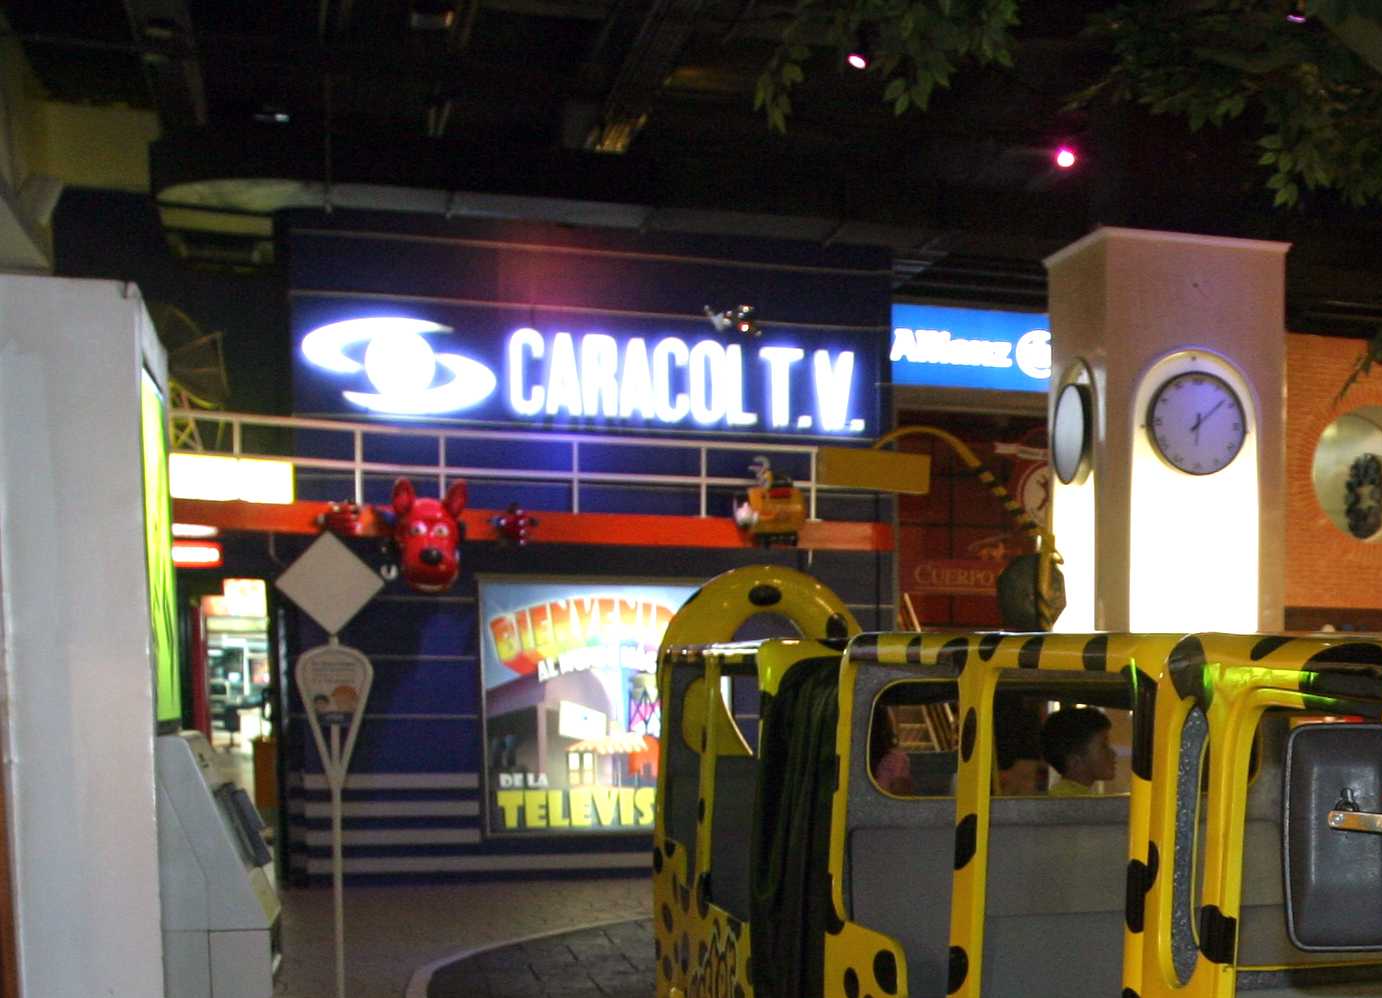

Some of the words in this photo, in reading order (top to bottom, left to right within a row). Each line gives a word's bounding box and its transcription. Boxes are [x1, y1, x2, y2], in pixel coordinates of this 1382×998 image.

[890, 328, 1013, 368] Allianz
[509, 328, 758, 425] CARACOL
[759, 346, 865, 431] T.V.
[538, 657, 558, 682] AL
[500, 773, 523, 787] DE
[527, 773, 549, 787] LA
